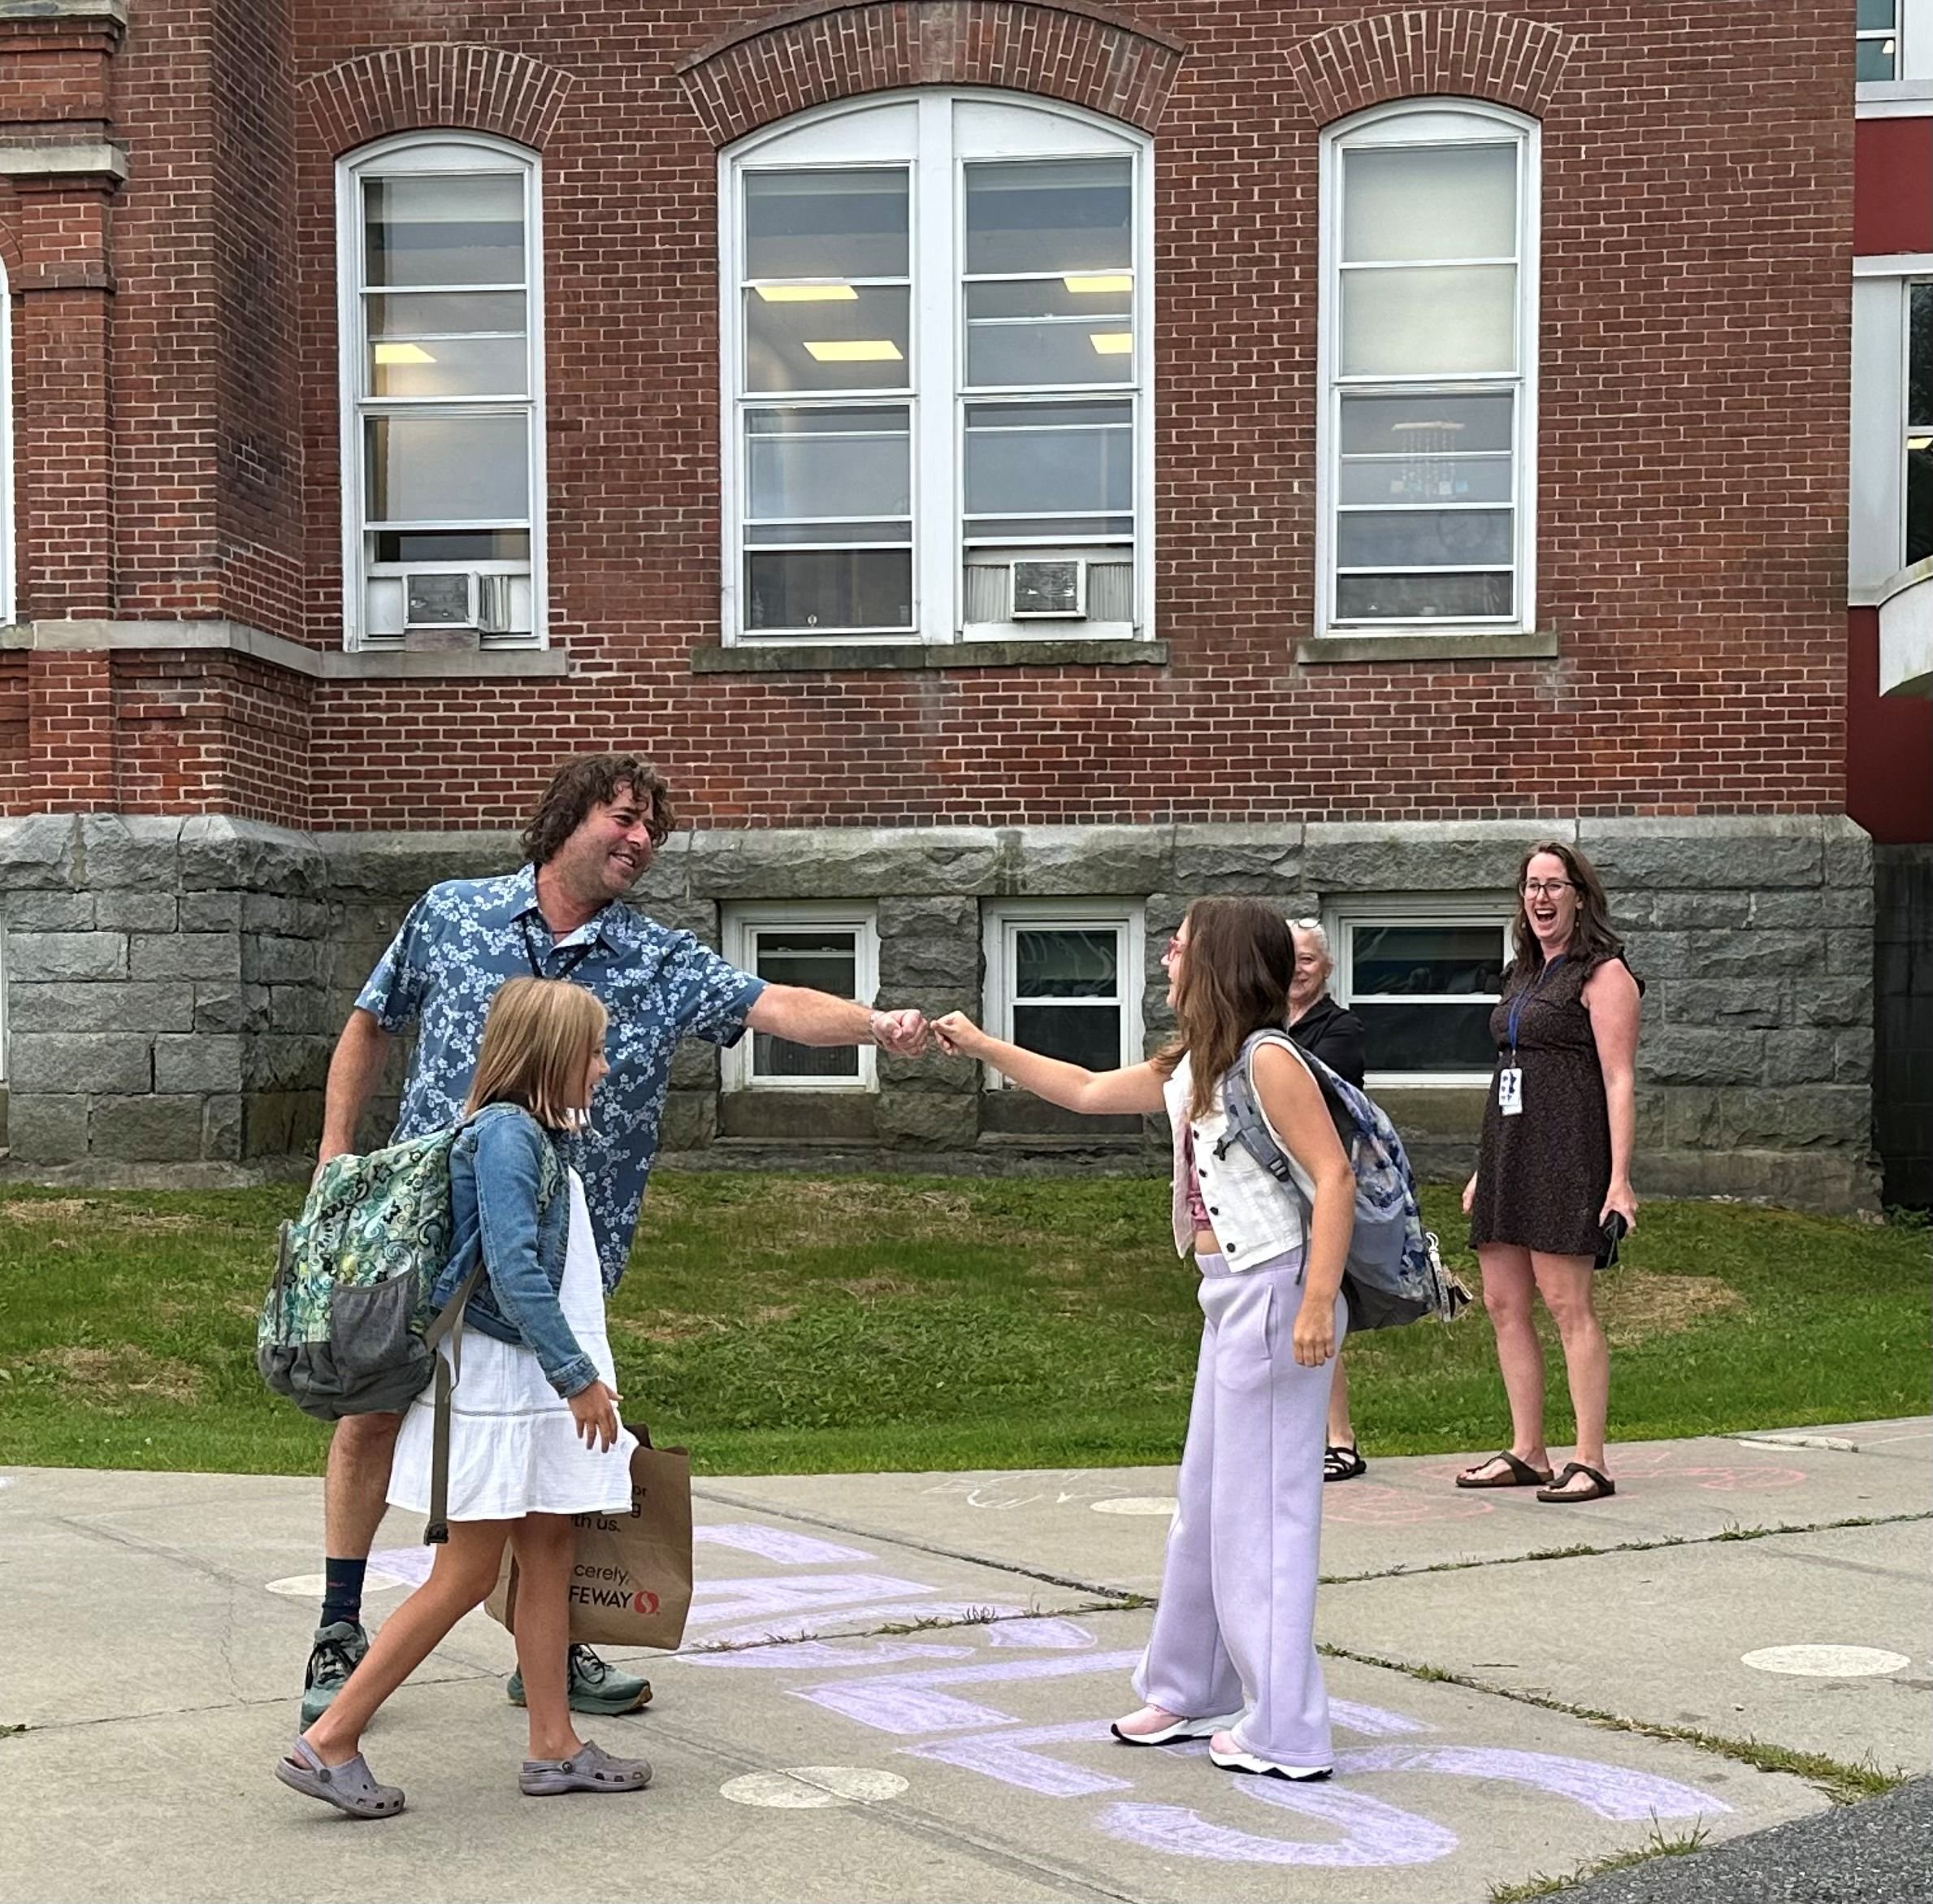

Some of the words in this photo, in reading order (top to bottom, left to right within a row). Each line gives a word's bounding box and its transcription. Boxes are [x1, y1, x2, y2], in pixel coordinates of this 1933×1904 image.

[632, 1485, 647, 1496] or
[572, 1514, 592, 1529] th
[596, 1518, 622, 1532] us.
[574, 1564, 631, 1586] cerely,
[569, 1585, 634, 1609] FEWAY
